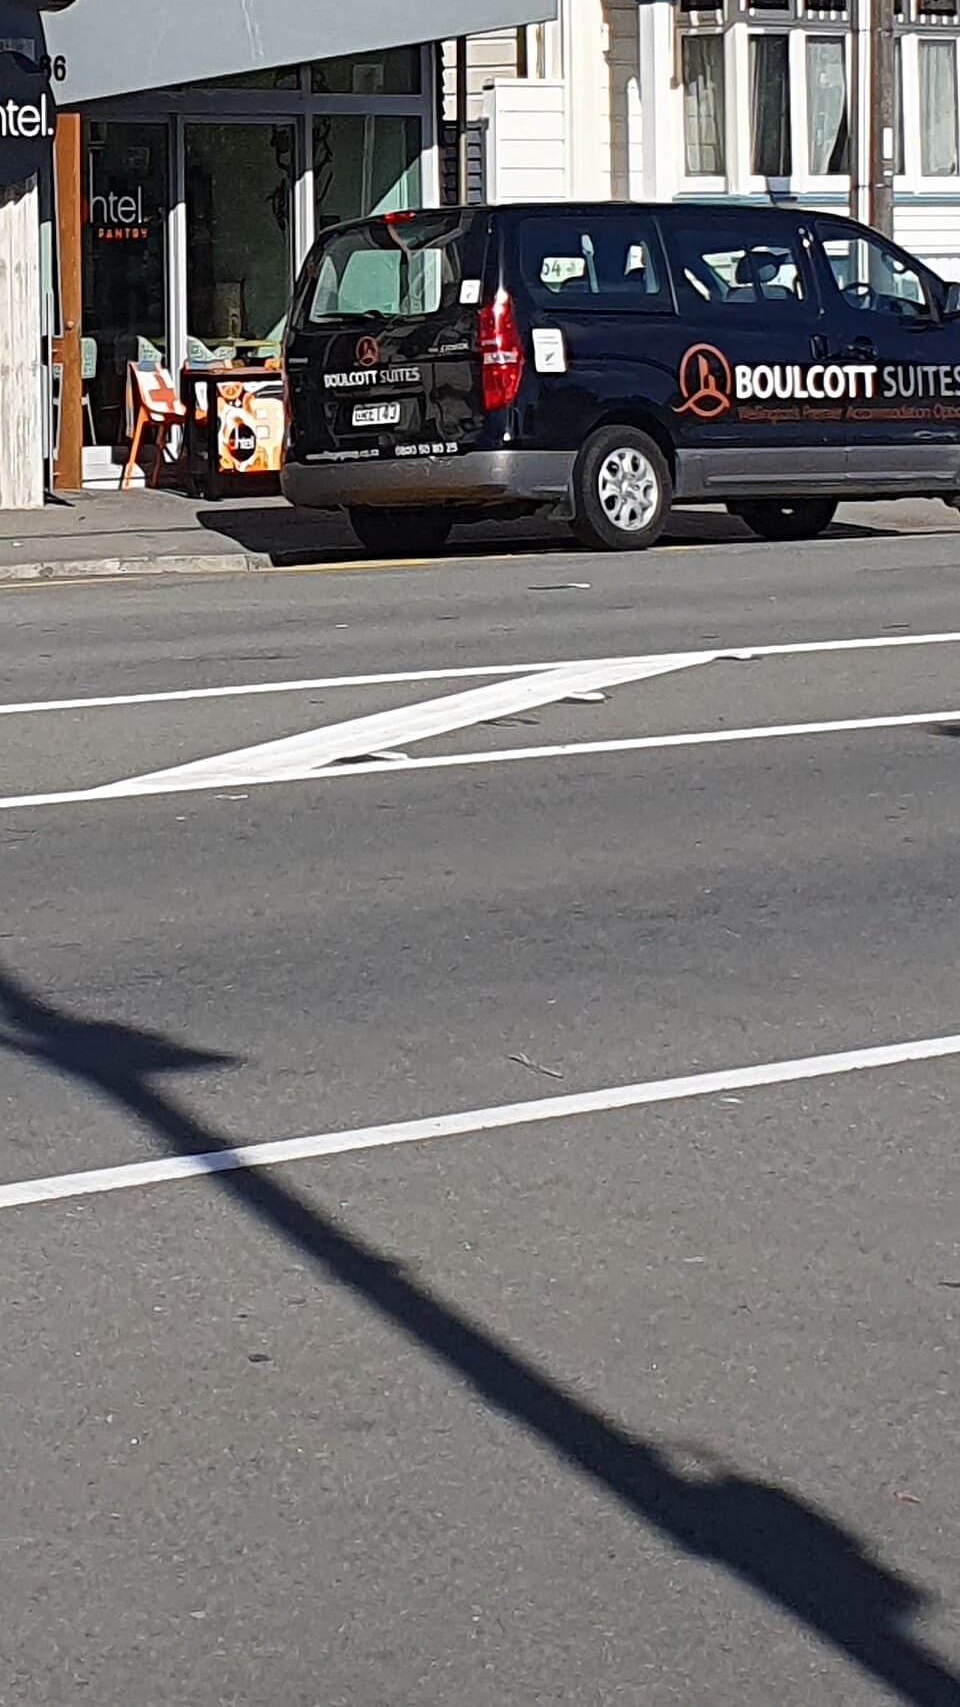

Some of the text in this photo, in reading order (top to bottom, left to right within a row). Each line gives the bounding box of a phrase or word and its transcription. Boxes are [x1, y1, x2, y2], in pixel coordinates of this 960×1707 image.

[98, 228, 147, 239] PANTRY
[324, 367, 420, 388] BOULCOTT SUITES
[735, 365, 960, 399] BOULCOTT SUITES
